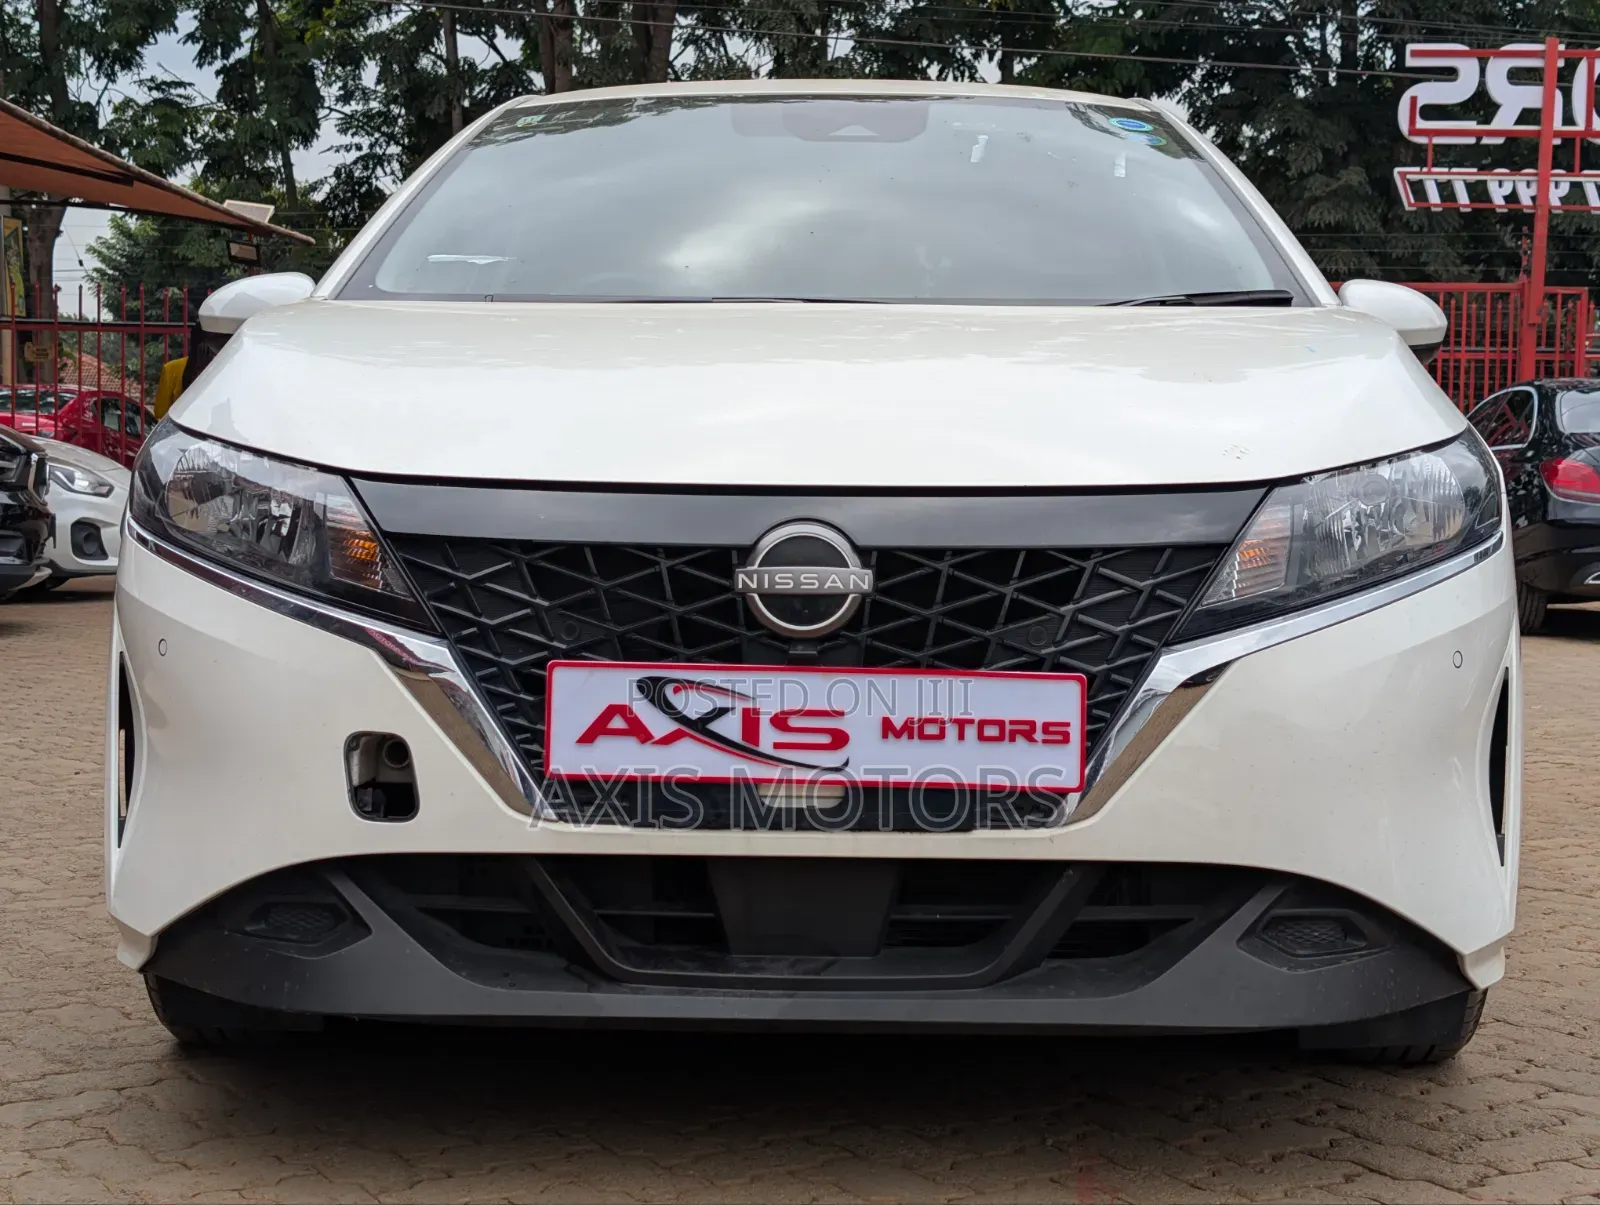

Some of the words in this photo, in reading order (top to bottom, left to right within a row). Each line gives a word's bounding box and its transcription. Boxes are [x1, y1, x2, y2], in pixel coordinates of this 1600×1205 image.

[738, 573, 869, 589] NISSAN
[574, 697, 851, 755] AXIS
[881, 717, 1071, 744] MOTORS
